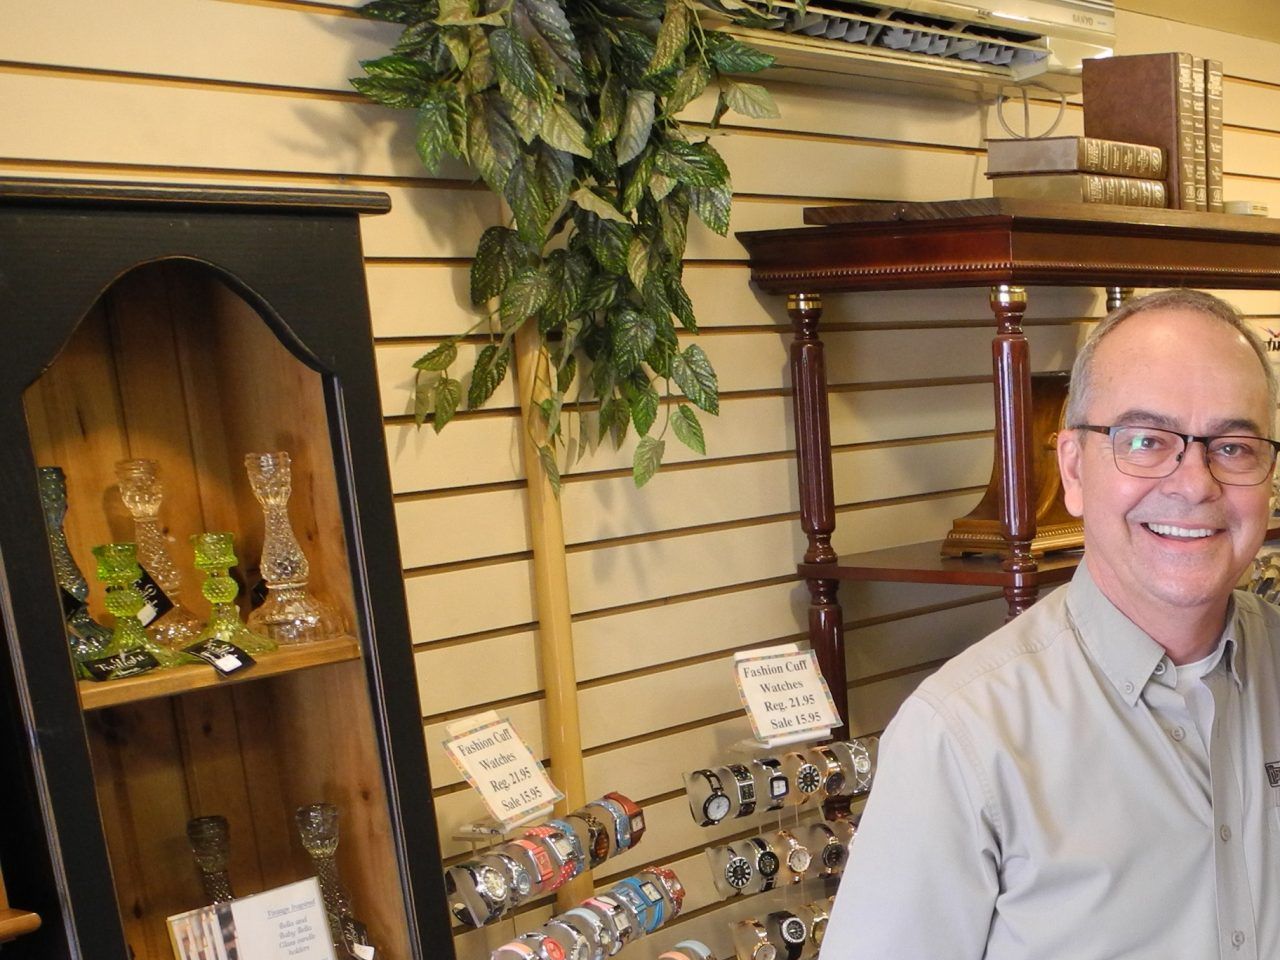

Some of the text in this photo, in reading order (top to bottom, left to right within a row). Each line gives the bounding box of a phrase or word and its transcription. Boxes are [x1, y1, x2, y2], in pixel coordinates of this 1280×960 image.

[95, 652, 146, 672] Twilight
[743, 660, 808, 678] Fashion Cuff
[760, 680, 804, 693] Watches
[764, 694, 816, 712] Reg. 21.95
[770, 711, 822, 730] Sale 15.95
[457, 728, 513, 757] Fashion Cuff
[479, 752, 517, 770] Watches
[490, 766, 532, 792] Reg. 21.95
[501, 786, 543, 812] Sale 15.95
